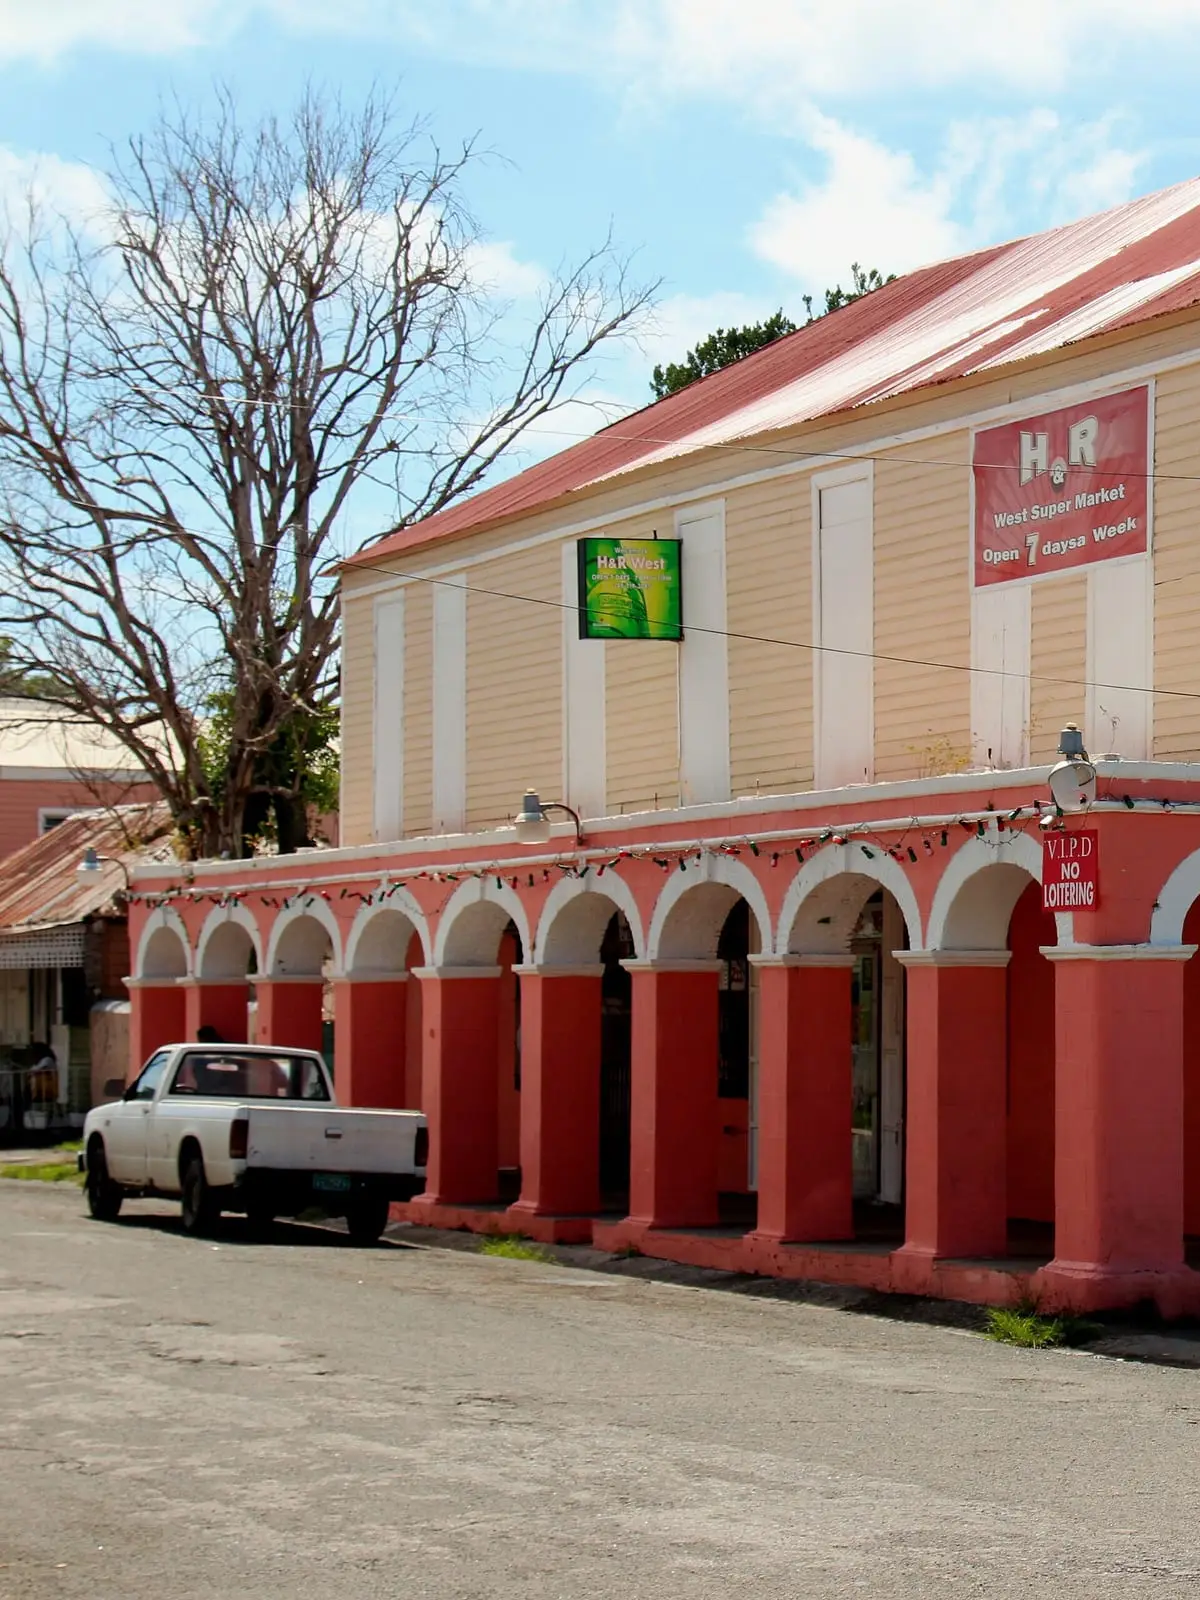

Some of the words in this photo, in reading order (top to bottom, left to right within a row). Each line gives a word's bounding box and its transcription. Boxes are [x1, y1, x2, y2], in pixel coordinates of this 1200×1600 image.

[1020, 431, 1049, 486] H
[1053, 463, 1066, 484] &
[1069, 415, 1098, 467] R
[994, 508, 1028, 528] West
[1031, 500, 1072, 519] Super
[1075, 483, 1126, 509] Market
[983, 548, 1019, 565] Open
[1025, 532, 1039, 566] 7
[1092, 516, 1137, 542] Week
[597, 555, 627, 569] H&R
[630, 556, 665, 570] West
[1061, 862, 1080, 880] NO
[1044, 881, 1094, 908] LOITERING
